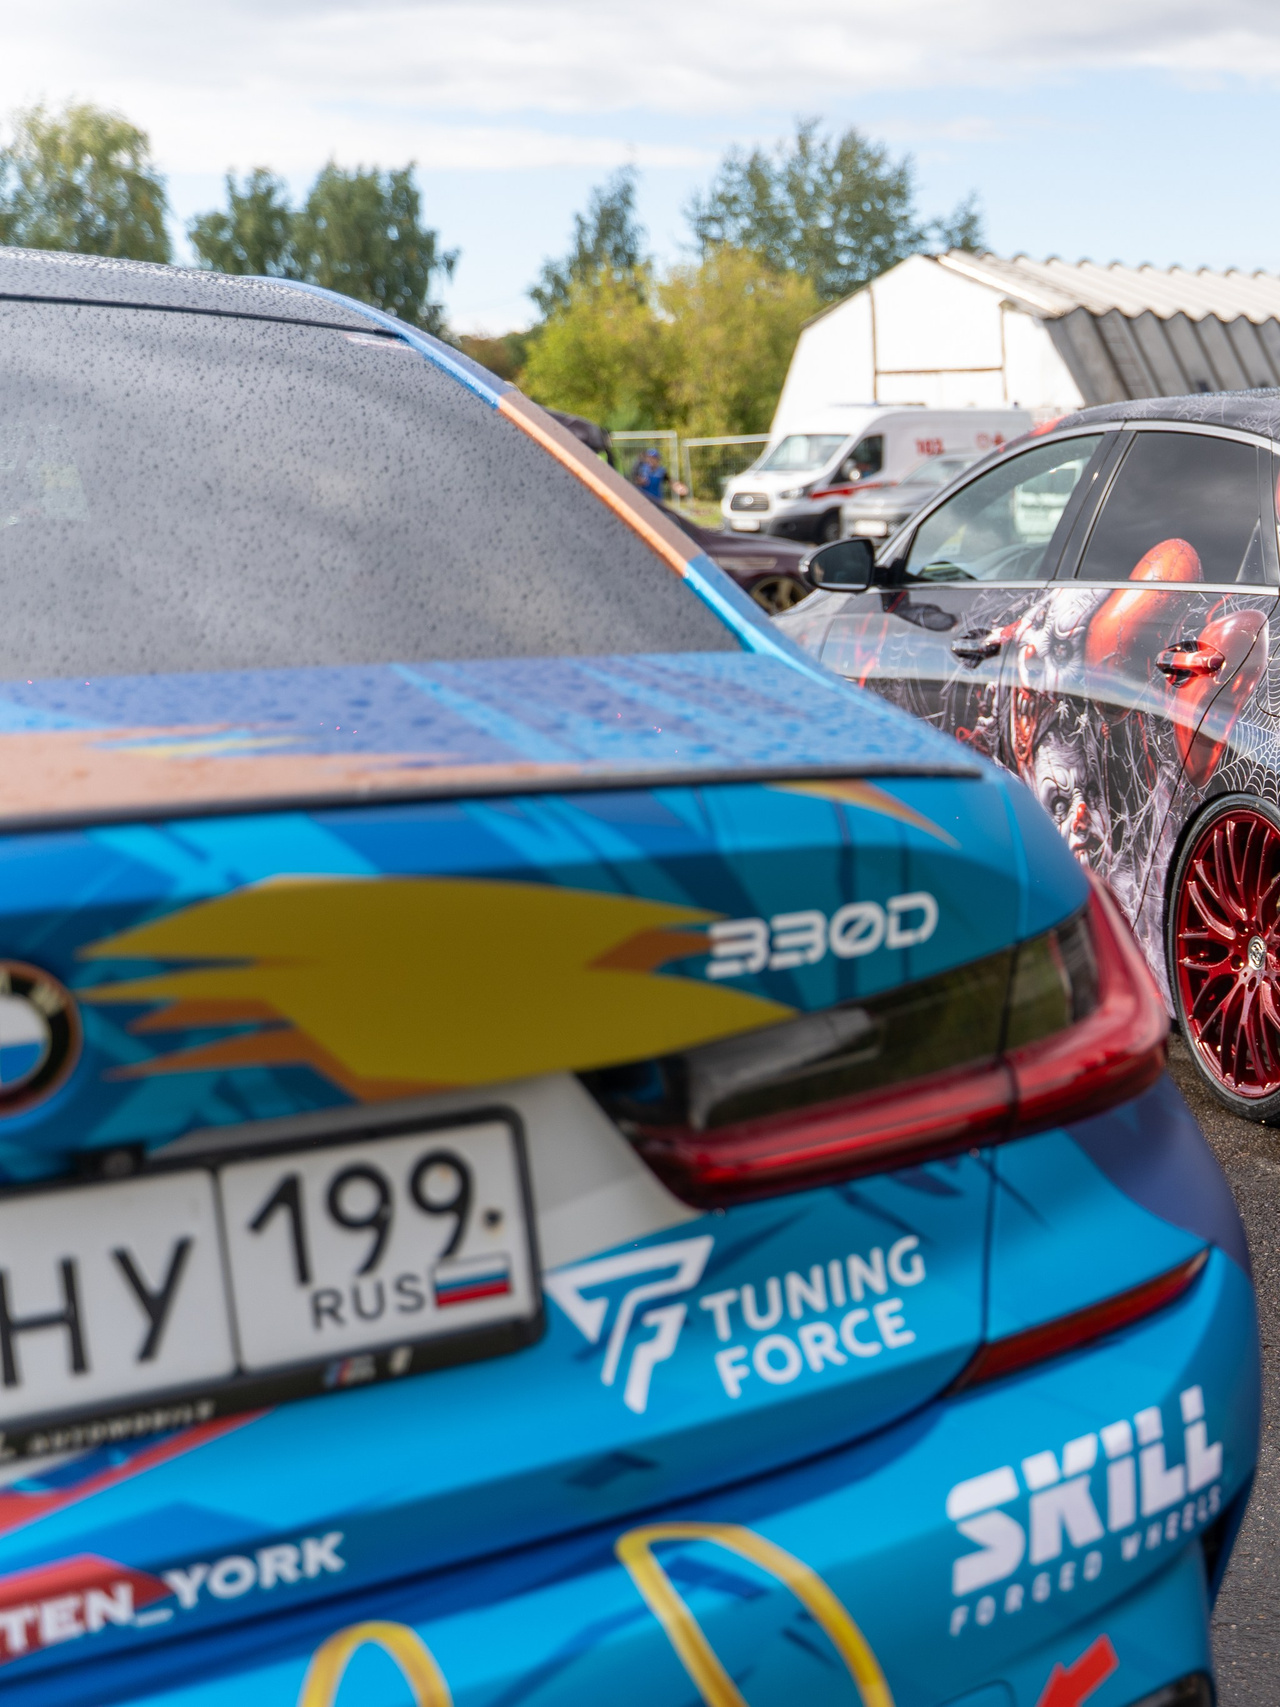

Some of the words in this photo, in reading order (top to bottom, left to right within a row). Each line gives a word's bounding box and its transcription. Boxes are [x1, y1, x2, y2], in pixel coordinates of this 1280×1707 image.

[705, 891, 939, 980] 330D
[246, 1146, 474, 1287] 199
[309, 1273, 427, 1332] RUS
[699, 1234, 926, 1342] TUNING
[714, 1298, 916, 1400] FORCE
[945, 1384, 1223, 1597] SKILL
[1120, 1485, 1222, 1562] WHEELS
[949, 1550, 1103, 1637] FORGED
